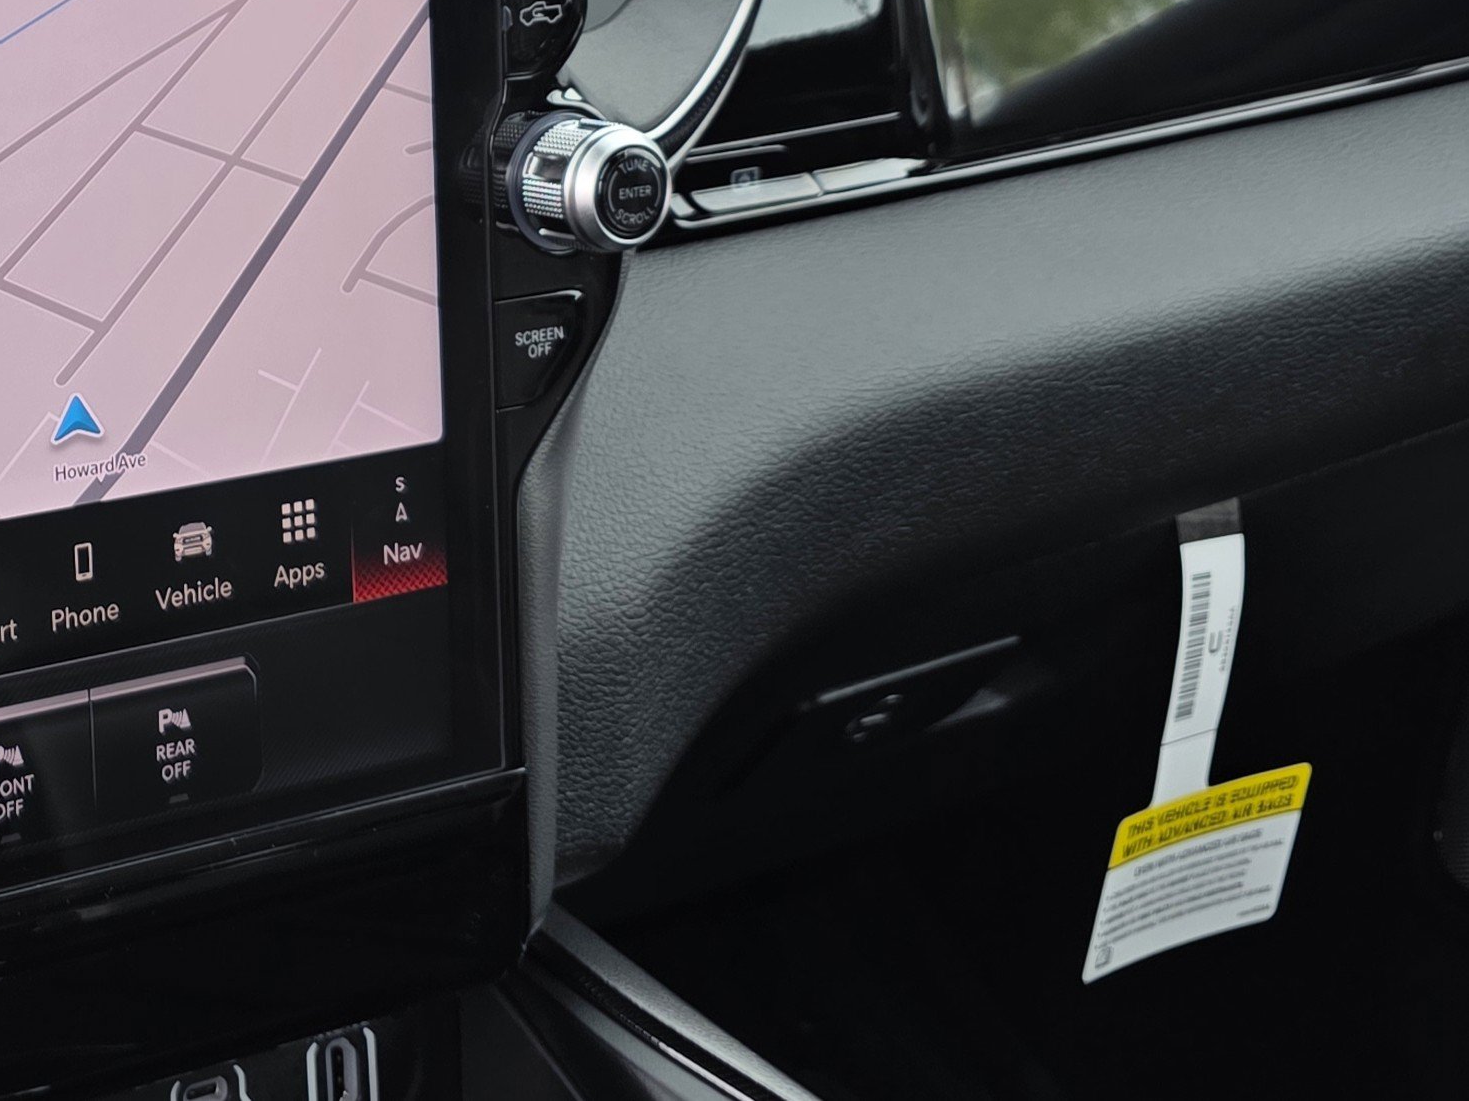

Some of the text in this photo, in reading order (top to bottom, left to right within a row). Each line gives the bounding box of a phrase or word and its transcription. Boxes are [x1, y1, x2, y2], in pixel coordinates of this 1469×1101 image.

[618, 158, 649, 174] TUNE
[619, 184, 652, 200] ENTER
[615, 206, 655, 225] SCROLL
[515, 326, 564, 346] SCREEN
[527, 342, 552, 358] OFF
[54, 452, 146, 482] Howard Ave
[395, 476, 406, 493] S
[383, 543, 422, 565] Nav
[274, 561, 326, 588] Apps
[155, 578, 232, 610] Vehicle
[51, 602, 119, 632] Phone
[156, 738, 195, 761] REAR
[161, 761, 192, 783] OFF
